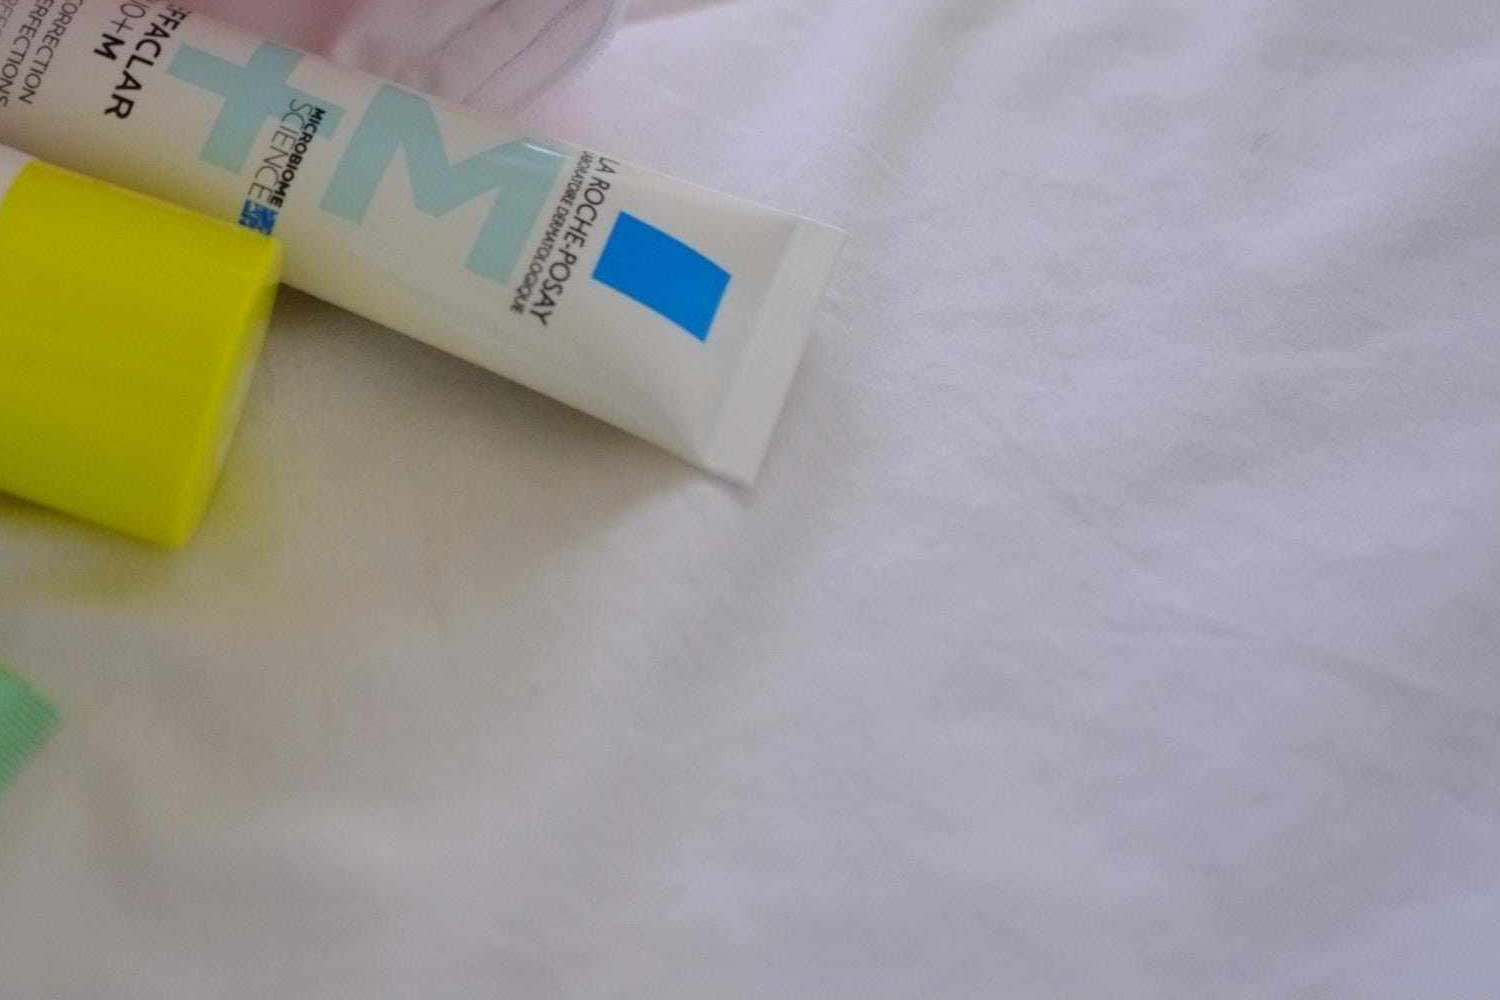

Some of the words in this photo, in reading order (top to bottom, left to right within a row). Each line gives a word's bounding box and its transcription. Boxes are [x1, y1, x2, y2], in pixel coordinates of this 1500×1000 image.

[247, 97, 302, 201] SCIENCE
[269, 106, 327, 209] MICROBIOME
[509, 204, 570, 315] DERMATOLOGIQUE
[529, 175, 611, 327] ROCHE-POSAY
